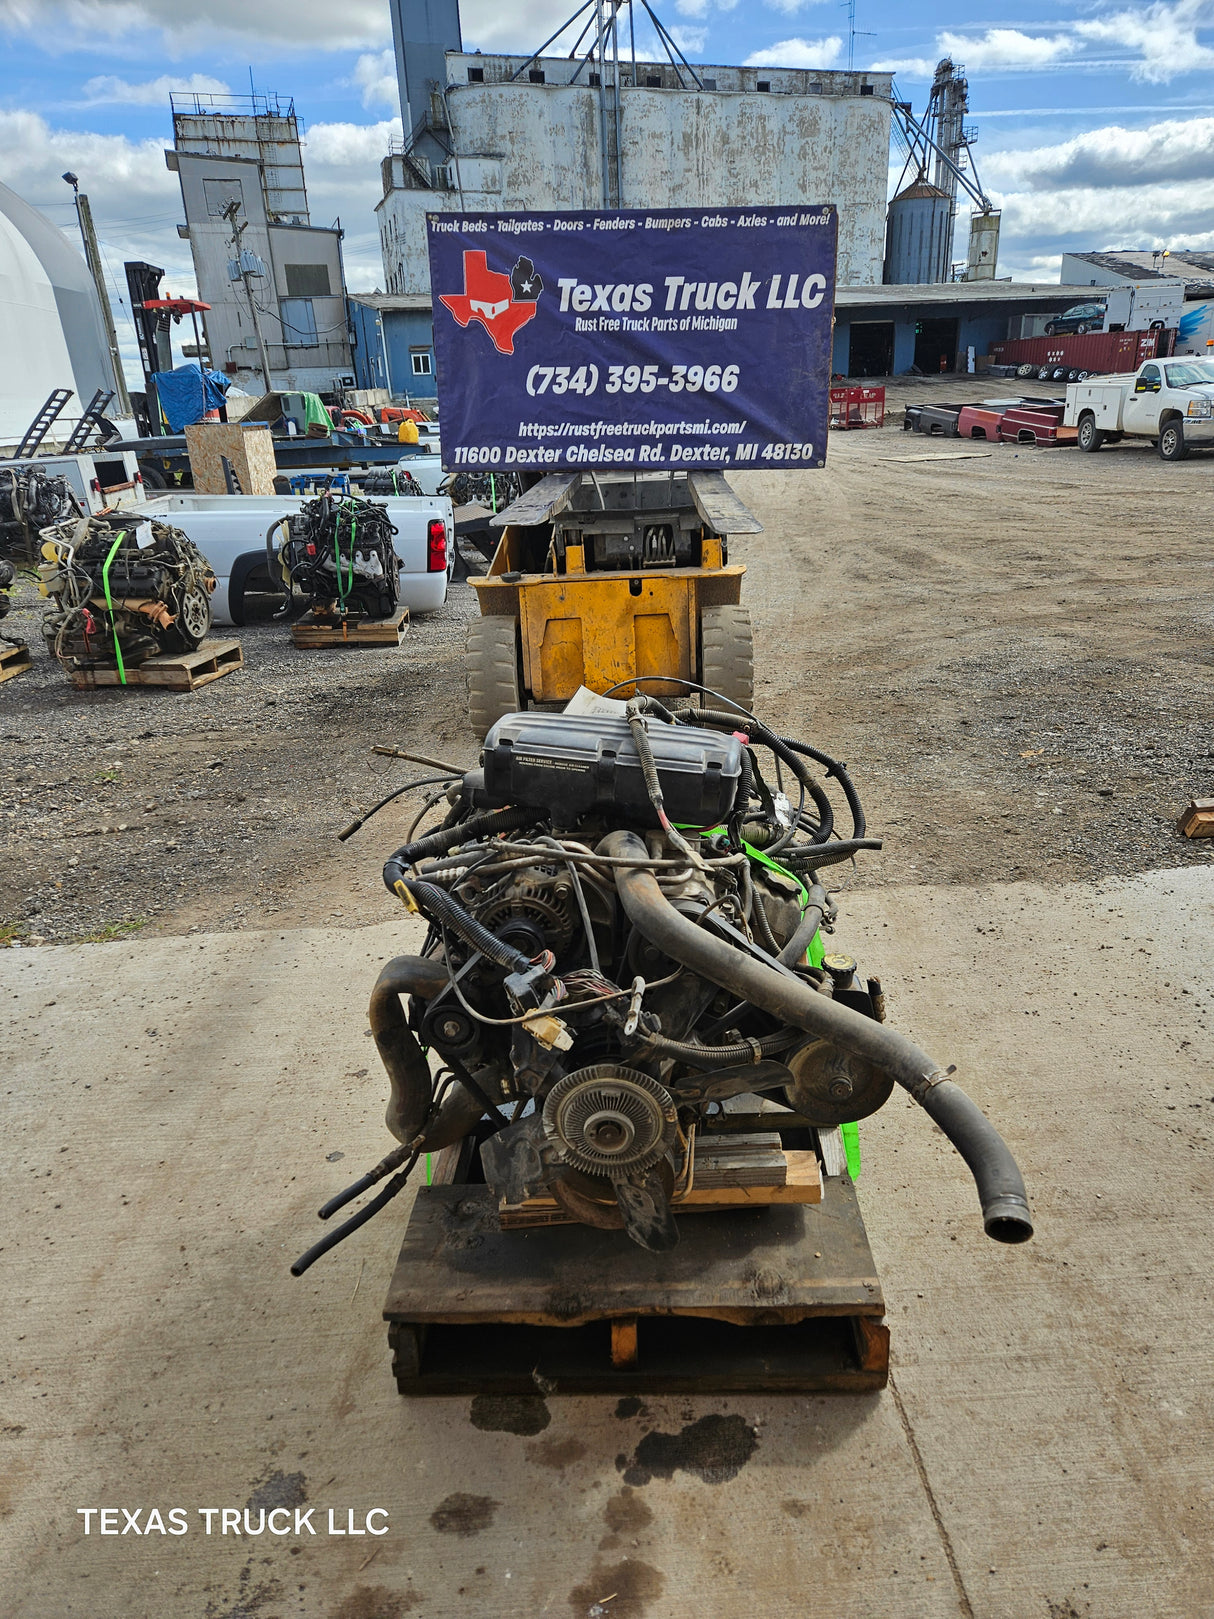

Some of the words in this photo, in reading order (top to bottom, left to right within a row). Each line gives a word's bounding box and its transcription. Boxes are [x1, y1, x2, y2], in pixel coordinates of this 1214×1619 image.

[431, 219, 460, 233] Truck
[461, 219, 488, 233] Beds
[497, 219, 544, 235] Tailgates
[553, 218, 584, 232] Doors
[593, 216, 635, 231] Fenders
[645, 216, 692, 232] Bumpers
[701, 215, 728, 228] Cabs
[736, 214, 767, 228] Axles
[776, 213, 798, 226] and
[799, 213, 831, 227] More!
[557, 277, 654, 313] Texas
[664, 271, 762, 312] Truck
[766, 273, 827, 309] LLC
[575, 316, 598, 332] Rust
[599, 316, 621, 332] Free
[622, 316, 650, 332] Truck
[651, 316, 678, 332] Parts
[679, 316, 691, 331] of
[691, 315, 738, 333] Michigan
[1140, 338, 1156, 347] ZIM
[525, 363, 599, 397] (734)
[605, 364, 740, 395] 395-3966
[518, 418, 747, 440] https://rustfreetruckpartsmi.com/
[454, 446, 501, 464] 11600
[505, 445, 562, 463] Dexter
[565, 444, 635, 463] Chelsea
[638, 442, 666, 462] Rd.
[669, 443, 731, 464] Dexter,
[734, 443, 759, 461] MI
[761, 443, 814, 461] 48130
